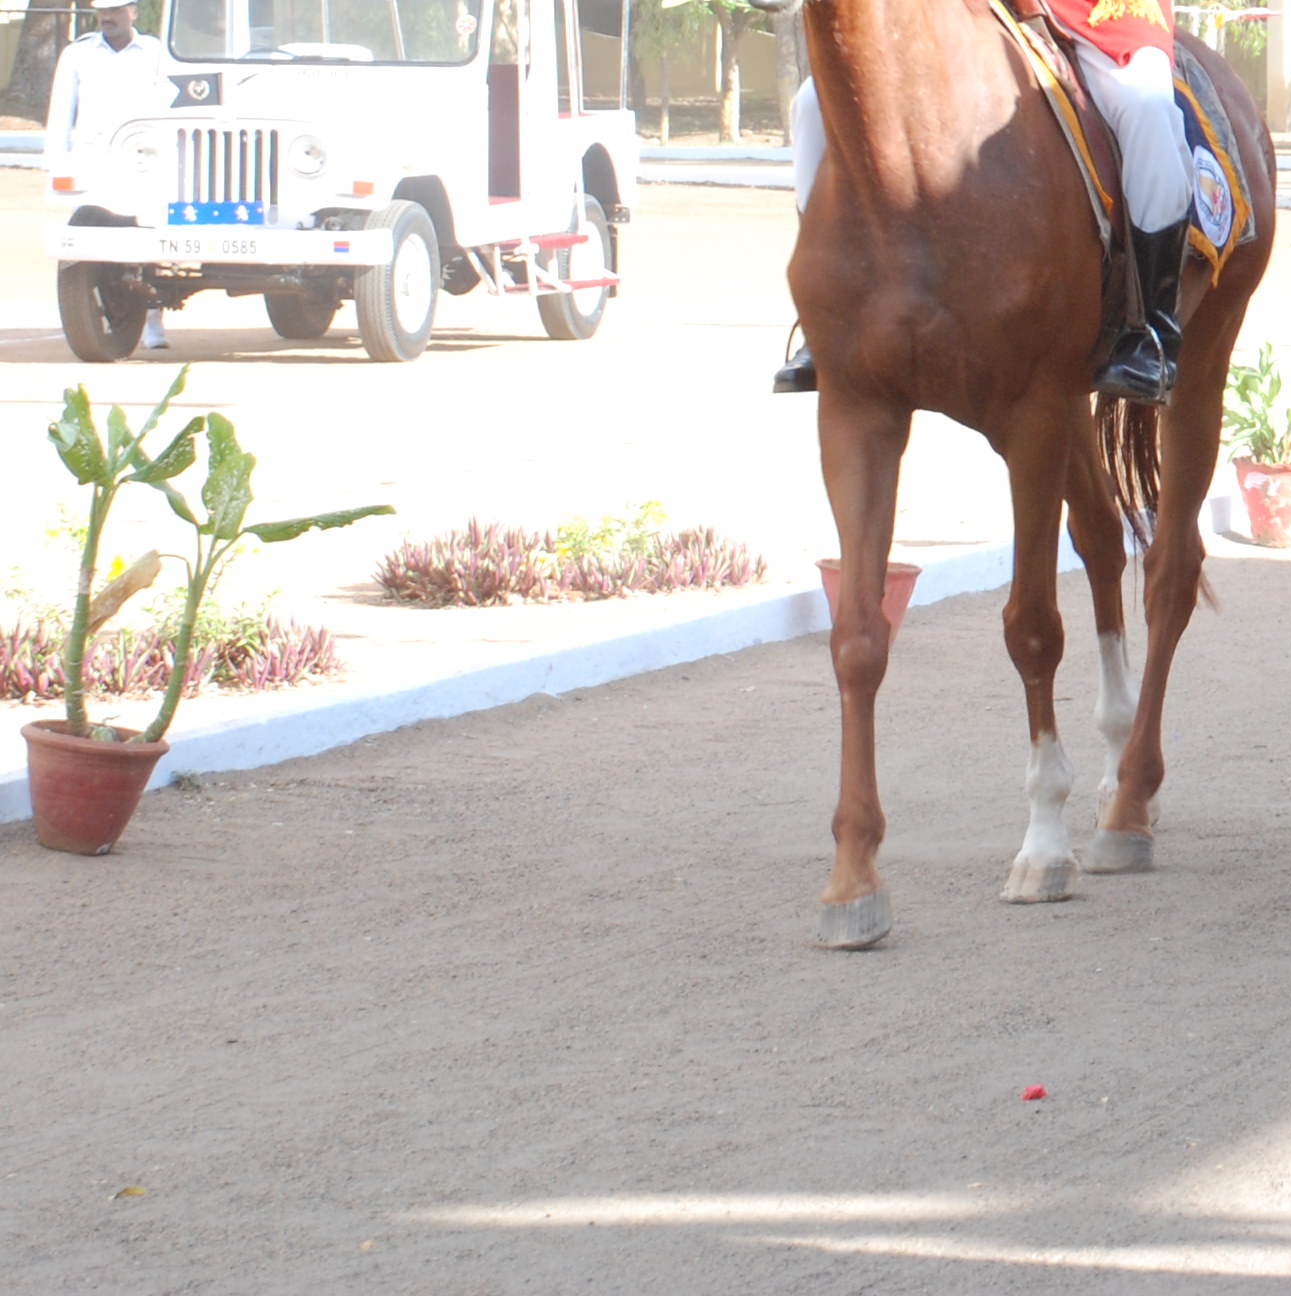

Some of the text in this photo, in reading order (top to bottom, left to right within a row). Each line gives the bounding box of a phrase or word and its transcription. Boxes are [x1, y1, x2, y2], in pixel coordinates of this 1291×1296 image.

[159, 239, 178, 253] TN
[185, 239, 201, 253] 59
[222, 240, 257, 254] 0585
